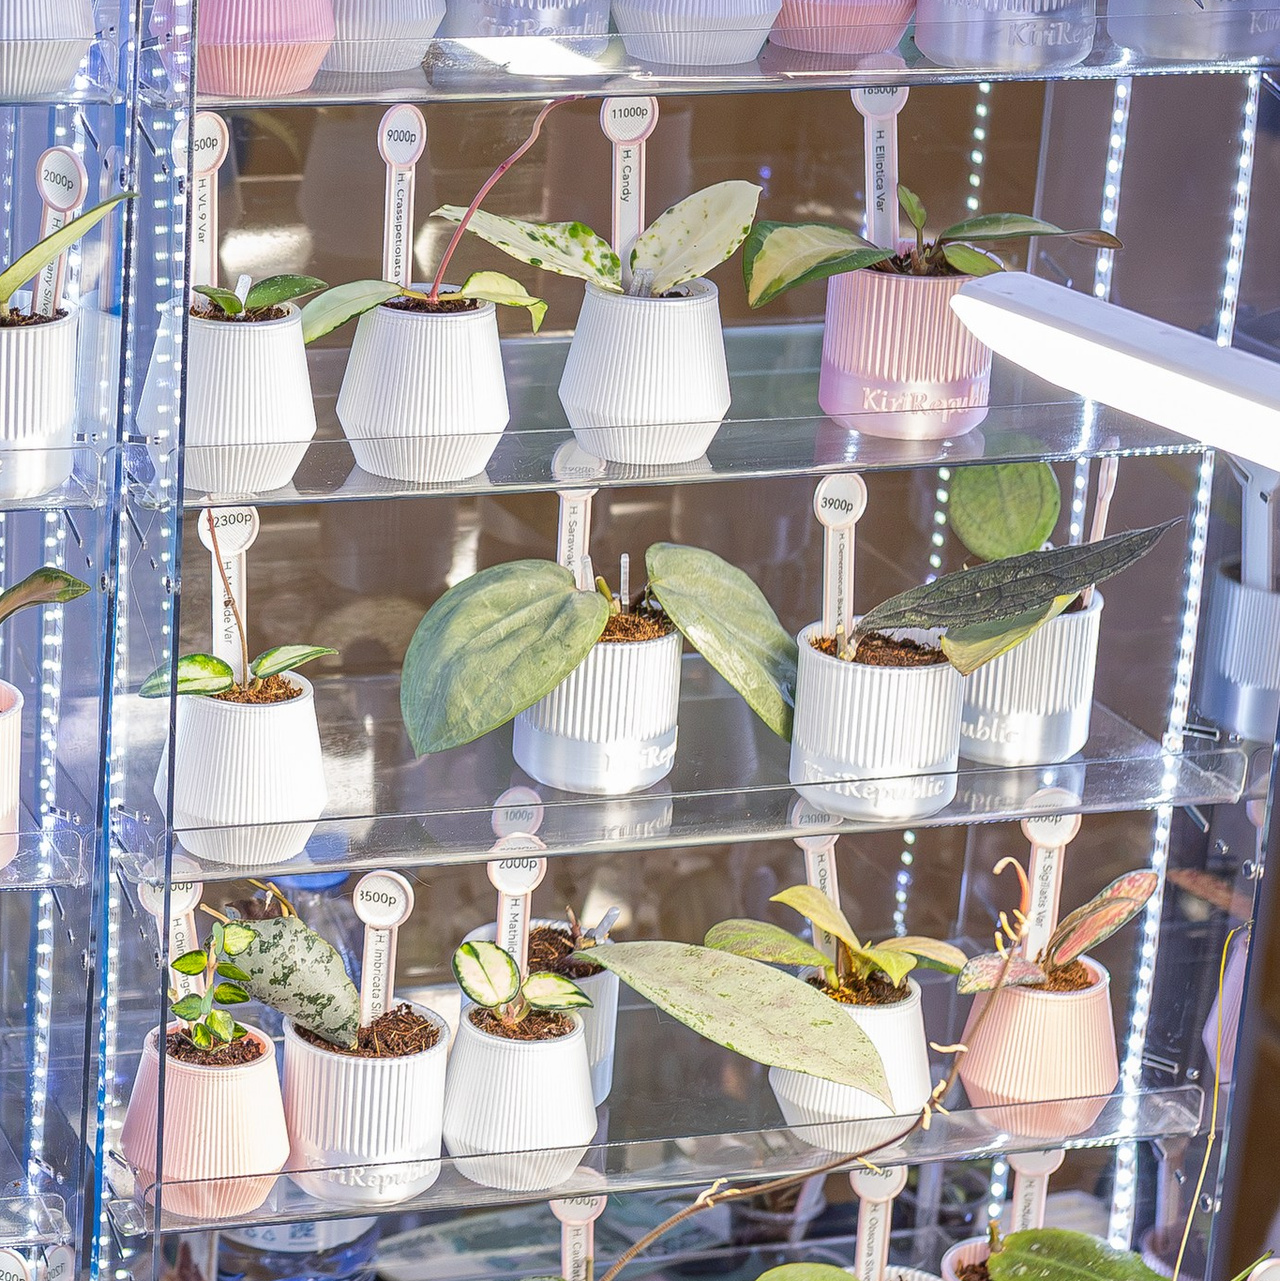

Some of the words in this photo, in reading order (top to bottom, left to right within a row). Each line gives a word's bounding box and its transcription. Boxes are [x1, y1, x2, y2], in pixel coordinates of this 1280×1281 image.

[875, 146, 886, 190] Elliptica
[620, 165, 632, 202] Candy
[876, 192, 885, 213] Var
[198, 223, 206, 243] Var
